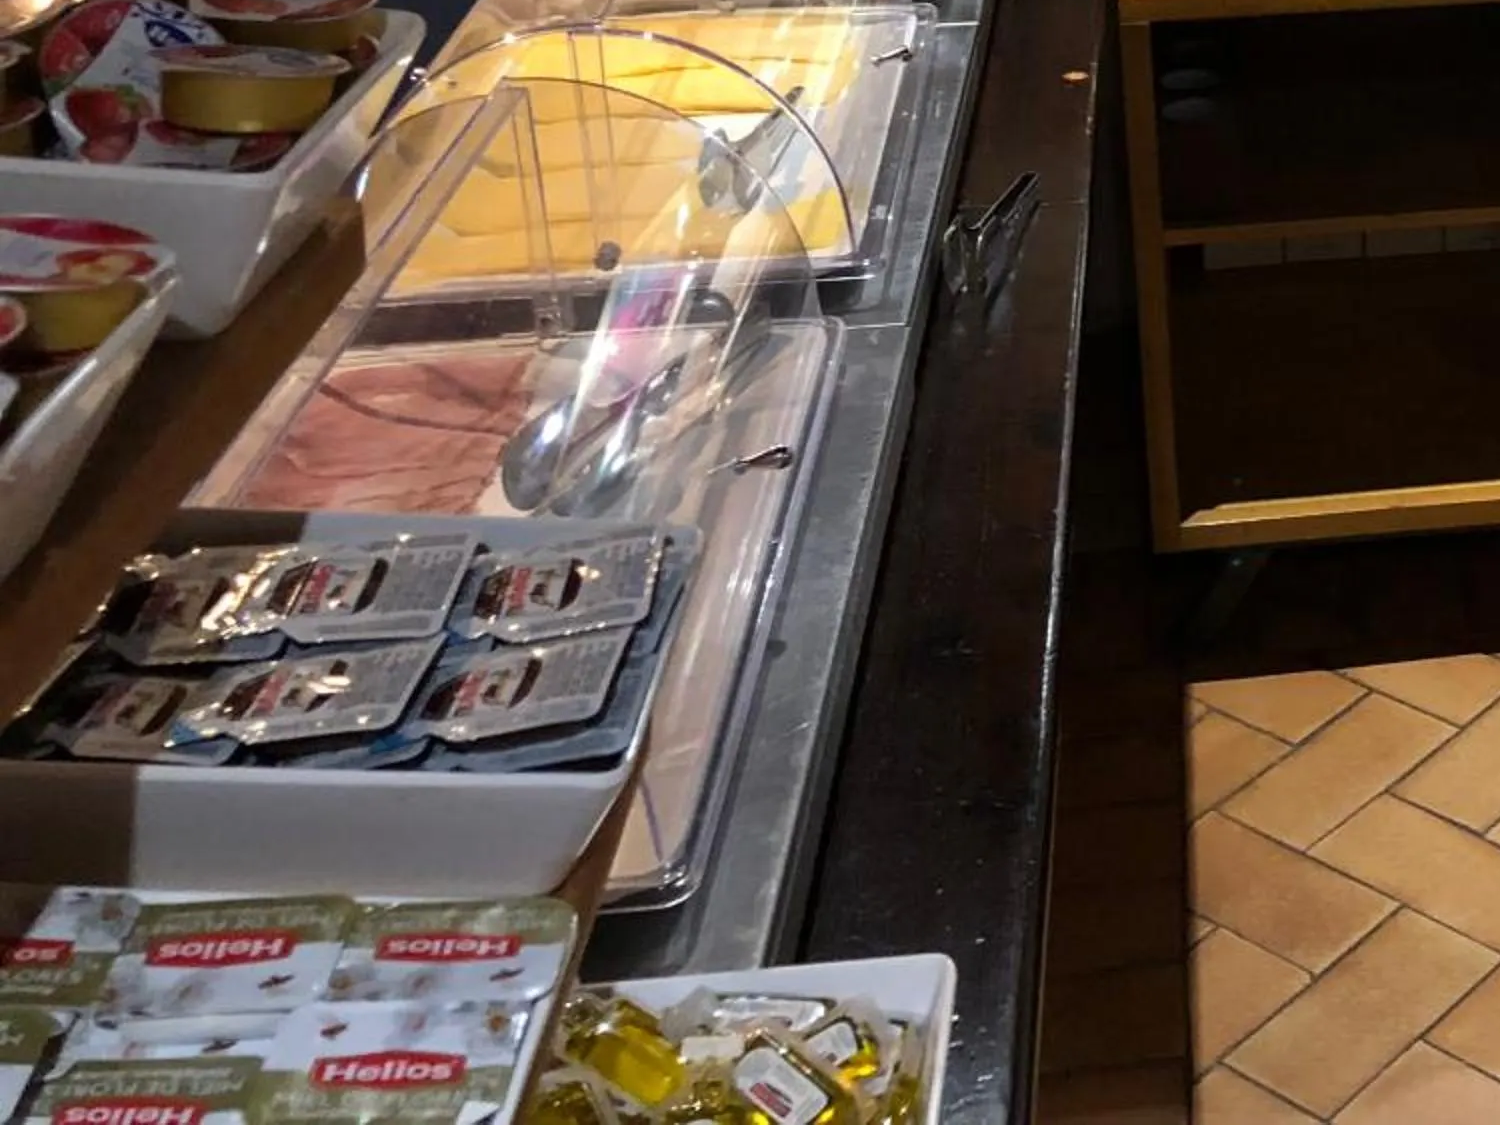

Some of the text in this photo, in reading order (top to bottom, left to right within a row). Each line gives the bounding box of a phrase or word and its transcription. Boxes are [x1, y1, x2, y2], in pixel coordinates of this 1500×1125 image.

[159, 937, 285, 960] Helios
[387, 937, 510, 957] Helios
[321, 1059, 453, 1084] Helios
[64, 1105, 196, 1125] Helios
